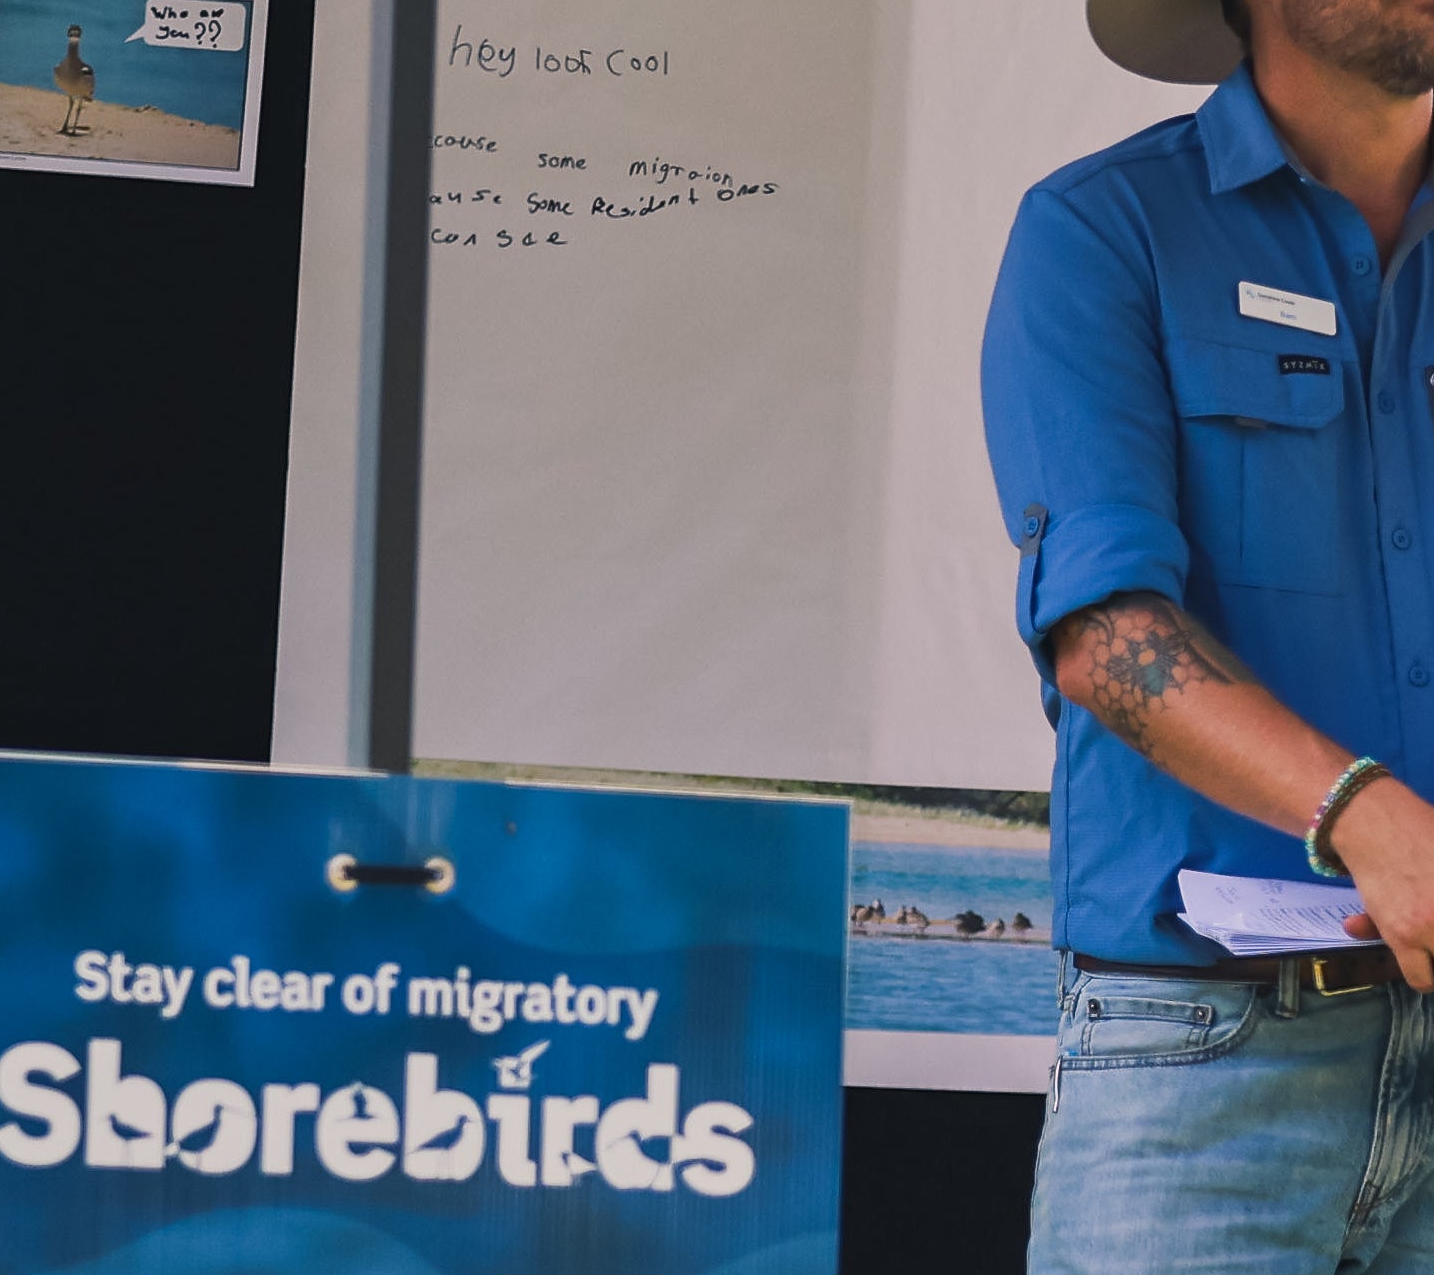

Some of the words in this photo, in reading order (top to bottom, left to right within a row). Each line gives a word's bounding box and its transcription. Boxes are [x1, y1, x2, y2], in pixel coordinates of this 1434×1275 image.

[151, 6, 189, 20] Who
[448, 24, 517, 77] hey
[535, 47, 592, 76] look
[73, 949, 193, 1019] Stay
[203, 955, 335, 1014] clear
[342, 962, 402, 1017] of
[408, 965, 659, 1043] migratory
